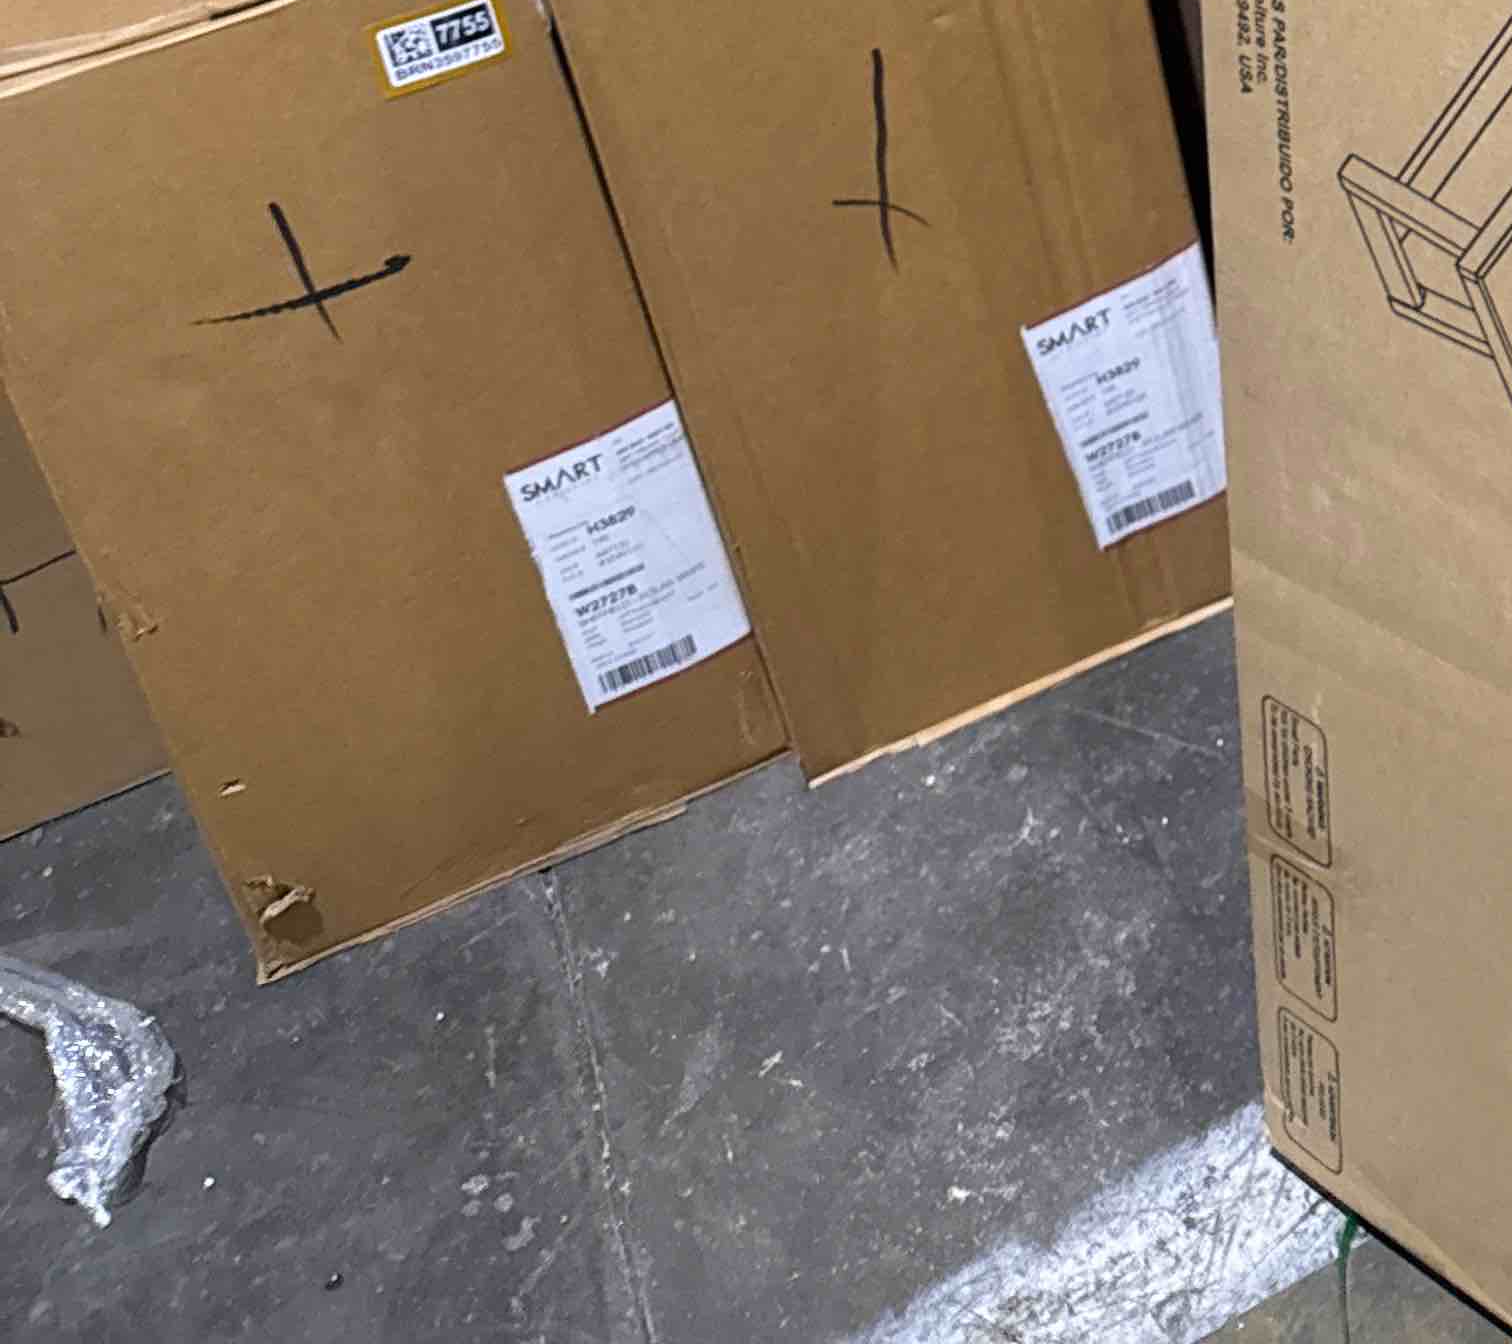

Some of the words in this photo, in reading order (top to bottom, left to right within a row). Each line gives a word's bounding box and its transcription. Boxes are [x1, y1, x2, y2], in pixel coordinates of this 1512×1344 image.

[435, 11, 489, 45] 7755
[1238, 54, 1252, 94] USA
[1257, 52, 1270, 84] Inc.
[1036, 308, 1111, 356] SMART
[519, 454, 604, 502] SMART
